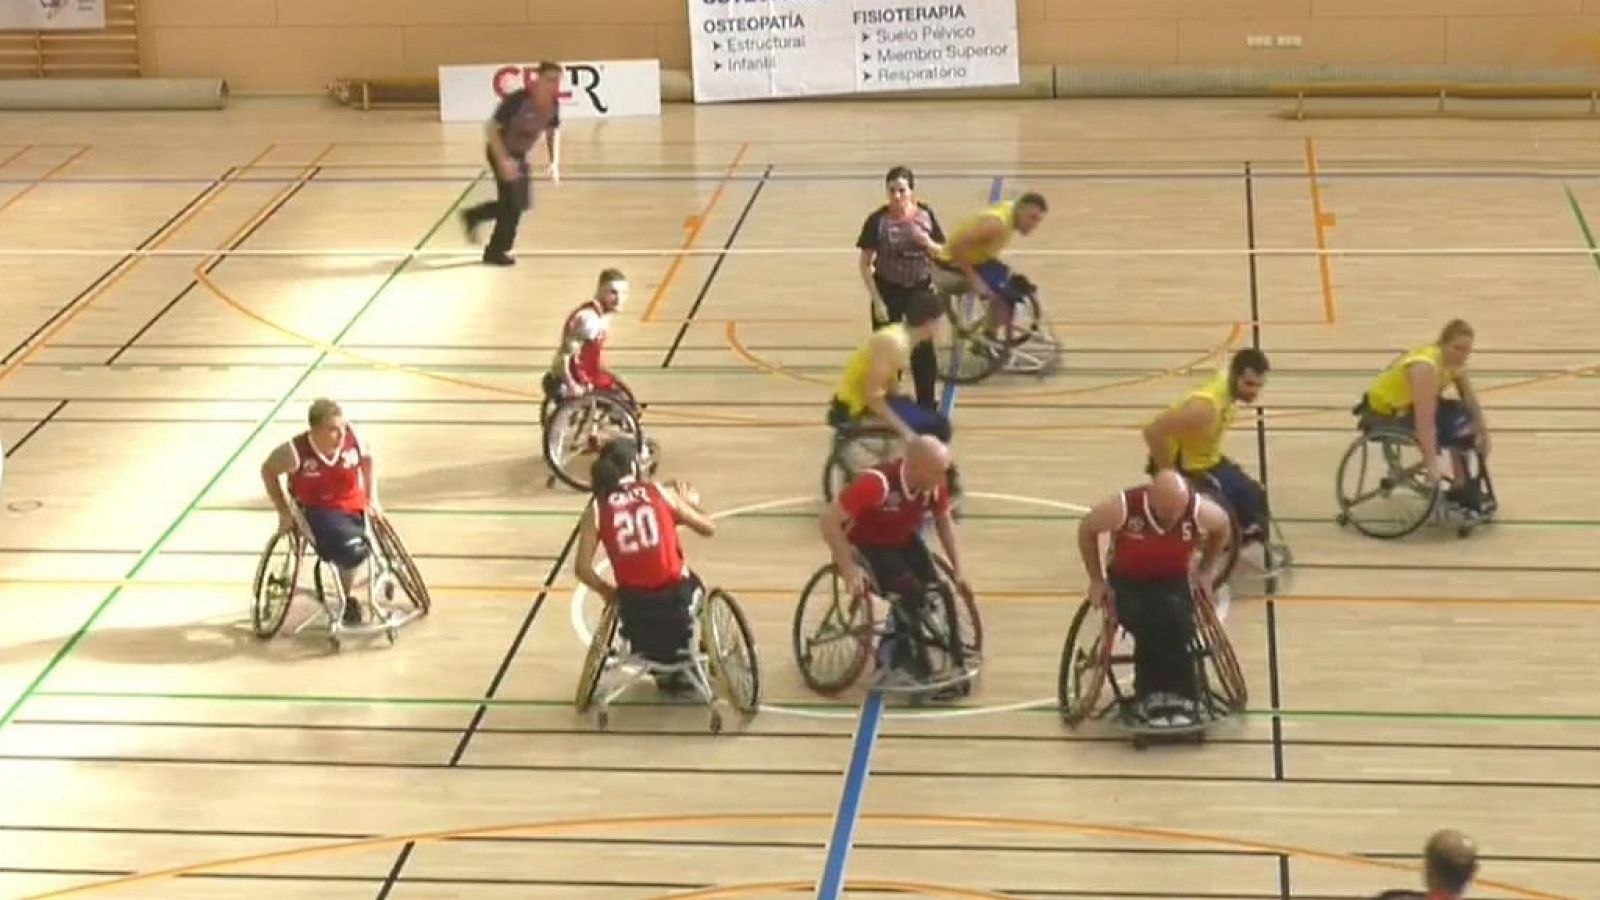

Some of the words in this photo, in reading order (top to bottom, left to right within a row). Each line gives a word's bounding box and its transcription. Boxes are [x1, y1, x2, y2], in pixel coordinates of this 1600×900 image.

[703, 10, 805, 34] OSTEOPATÍA
[853, 4, 966, 25] FISIOTERAPIA
[727, 36, 806, 52] Estructural
[876, 28, 918, 43] Suelo
[877, 46, 943, 62] Miembro
[946, 43, 1009, 59] Superior
[613, 504, 659, 553] 20
